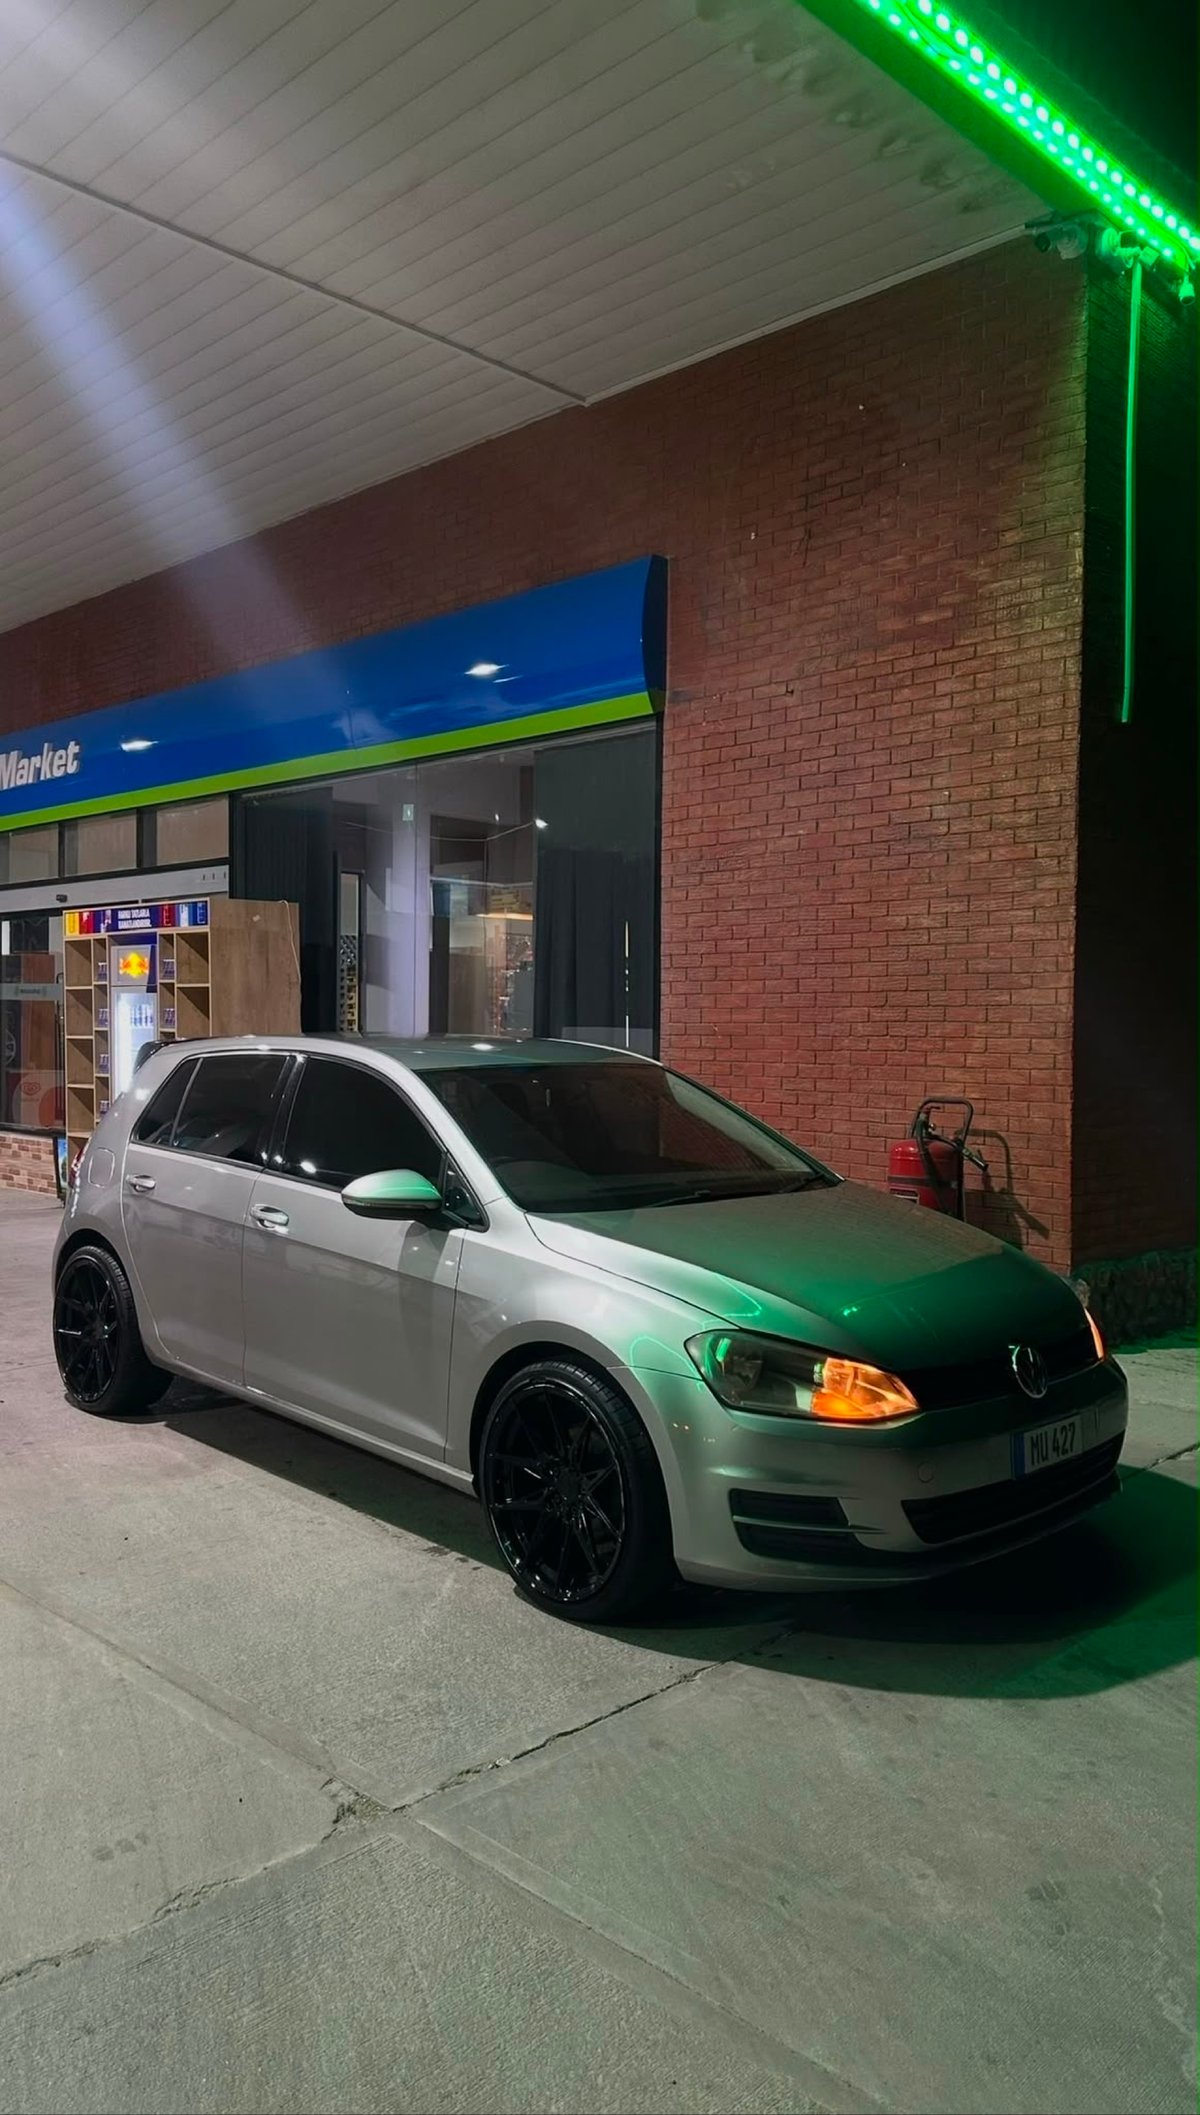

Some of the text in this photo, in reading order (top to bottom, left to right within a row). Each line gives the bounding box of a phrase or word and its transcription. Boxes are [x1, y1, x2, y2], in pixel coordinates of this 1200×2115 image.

[0, 741, 80, 791] Market
[1030, 1422, 1075, 1466] MU 427
